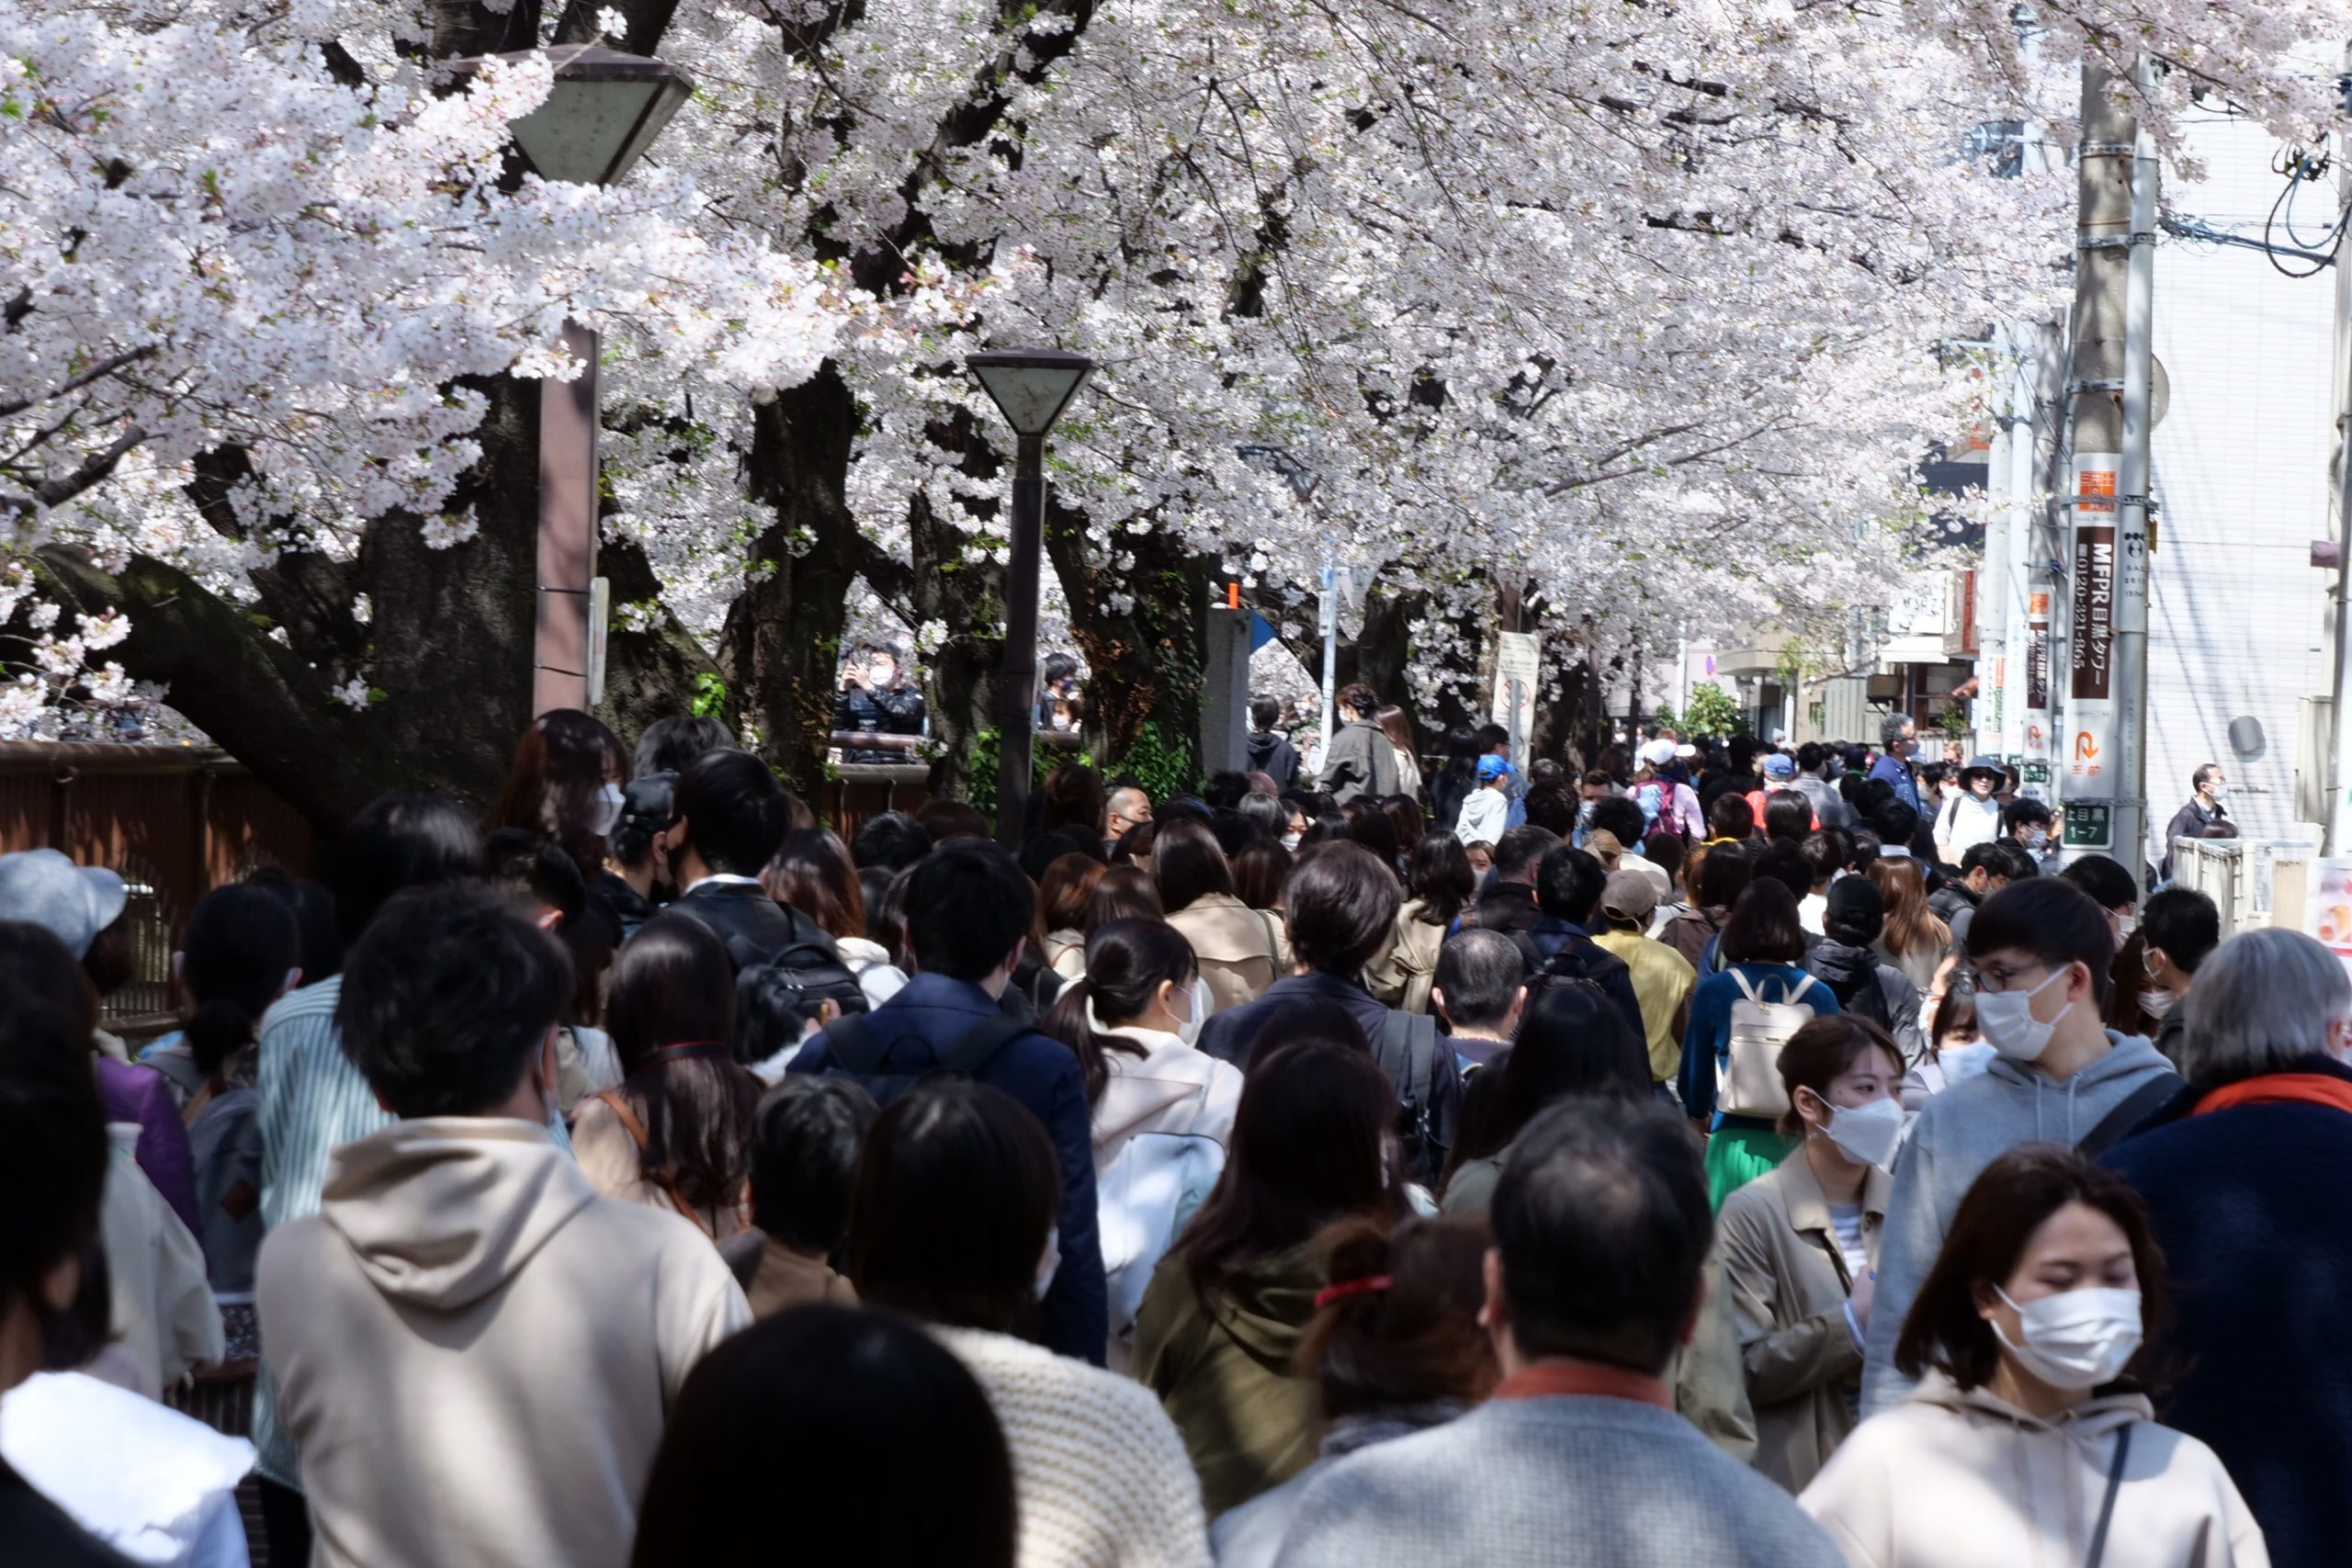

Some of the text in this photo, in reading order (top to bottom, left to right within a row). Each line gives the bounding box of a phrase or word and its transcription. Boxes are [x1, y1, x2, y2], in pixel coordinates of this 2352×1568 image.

[2072, 764, 2101, 778] 手前
[2065, 807, 2106, 822] 上目黒
[2069, 826, 2098, 840] 1-7
